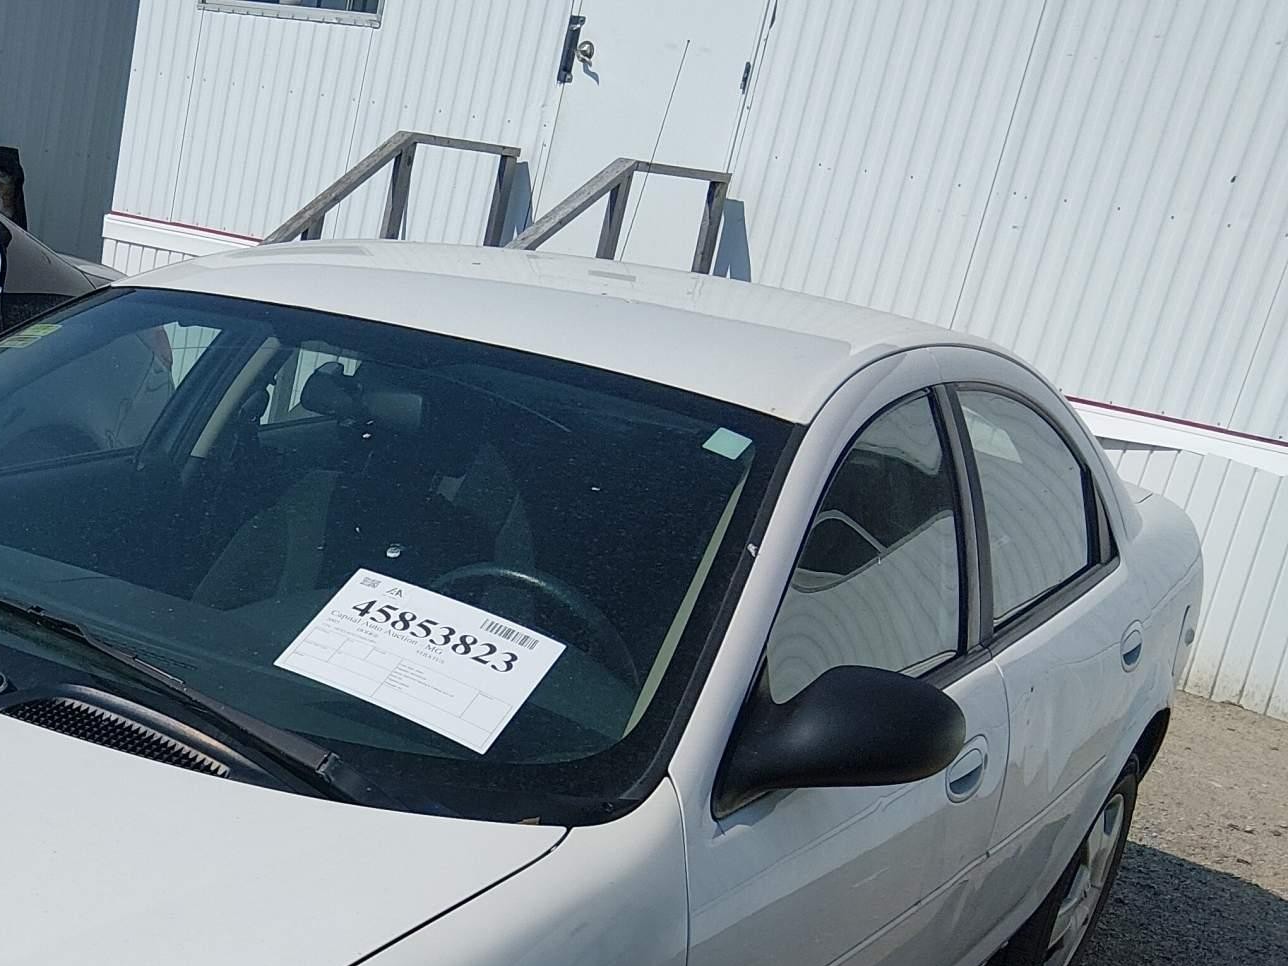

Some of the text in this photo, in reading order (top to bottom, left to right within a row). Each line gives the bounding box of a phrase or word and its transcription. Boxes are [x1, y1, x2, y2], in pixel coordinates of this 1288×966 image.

[331, 609, 361, 624] Capital
[362, 620, 383, 632] Auto
[383, 628, 419, 646] Auction
[352, 599, 518, 673] 45853823
